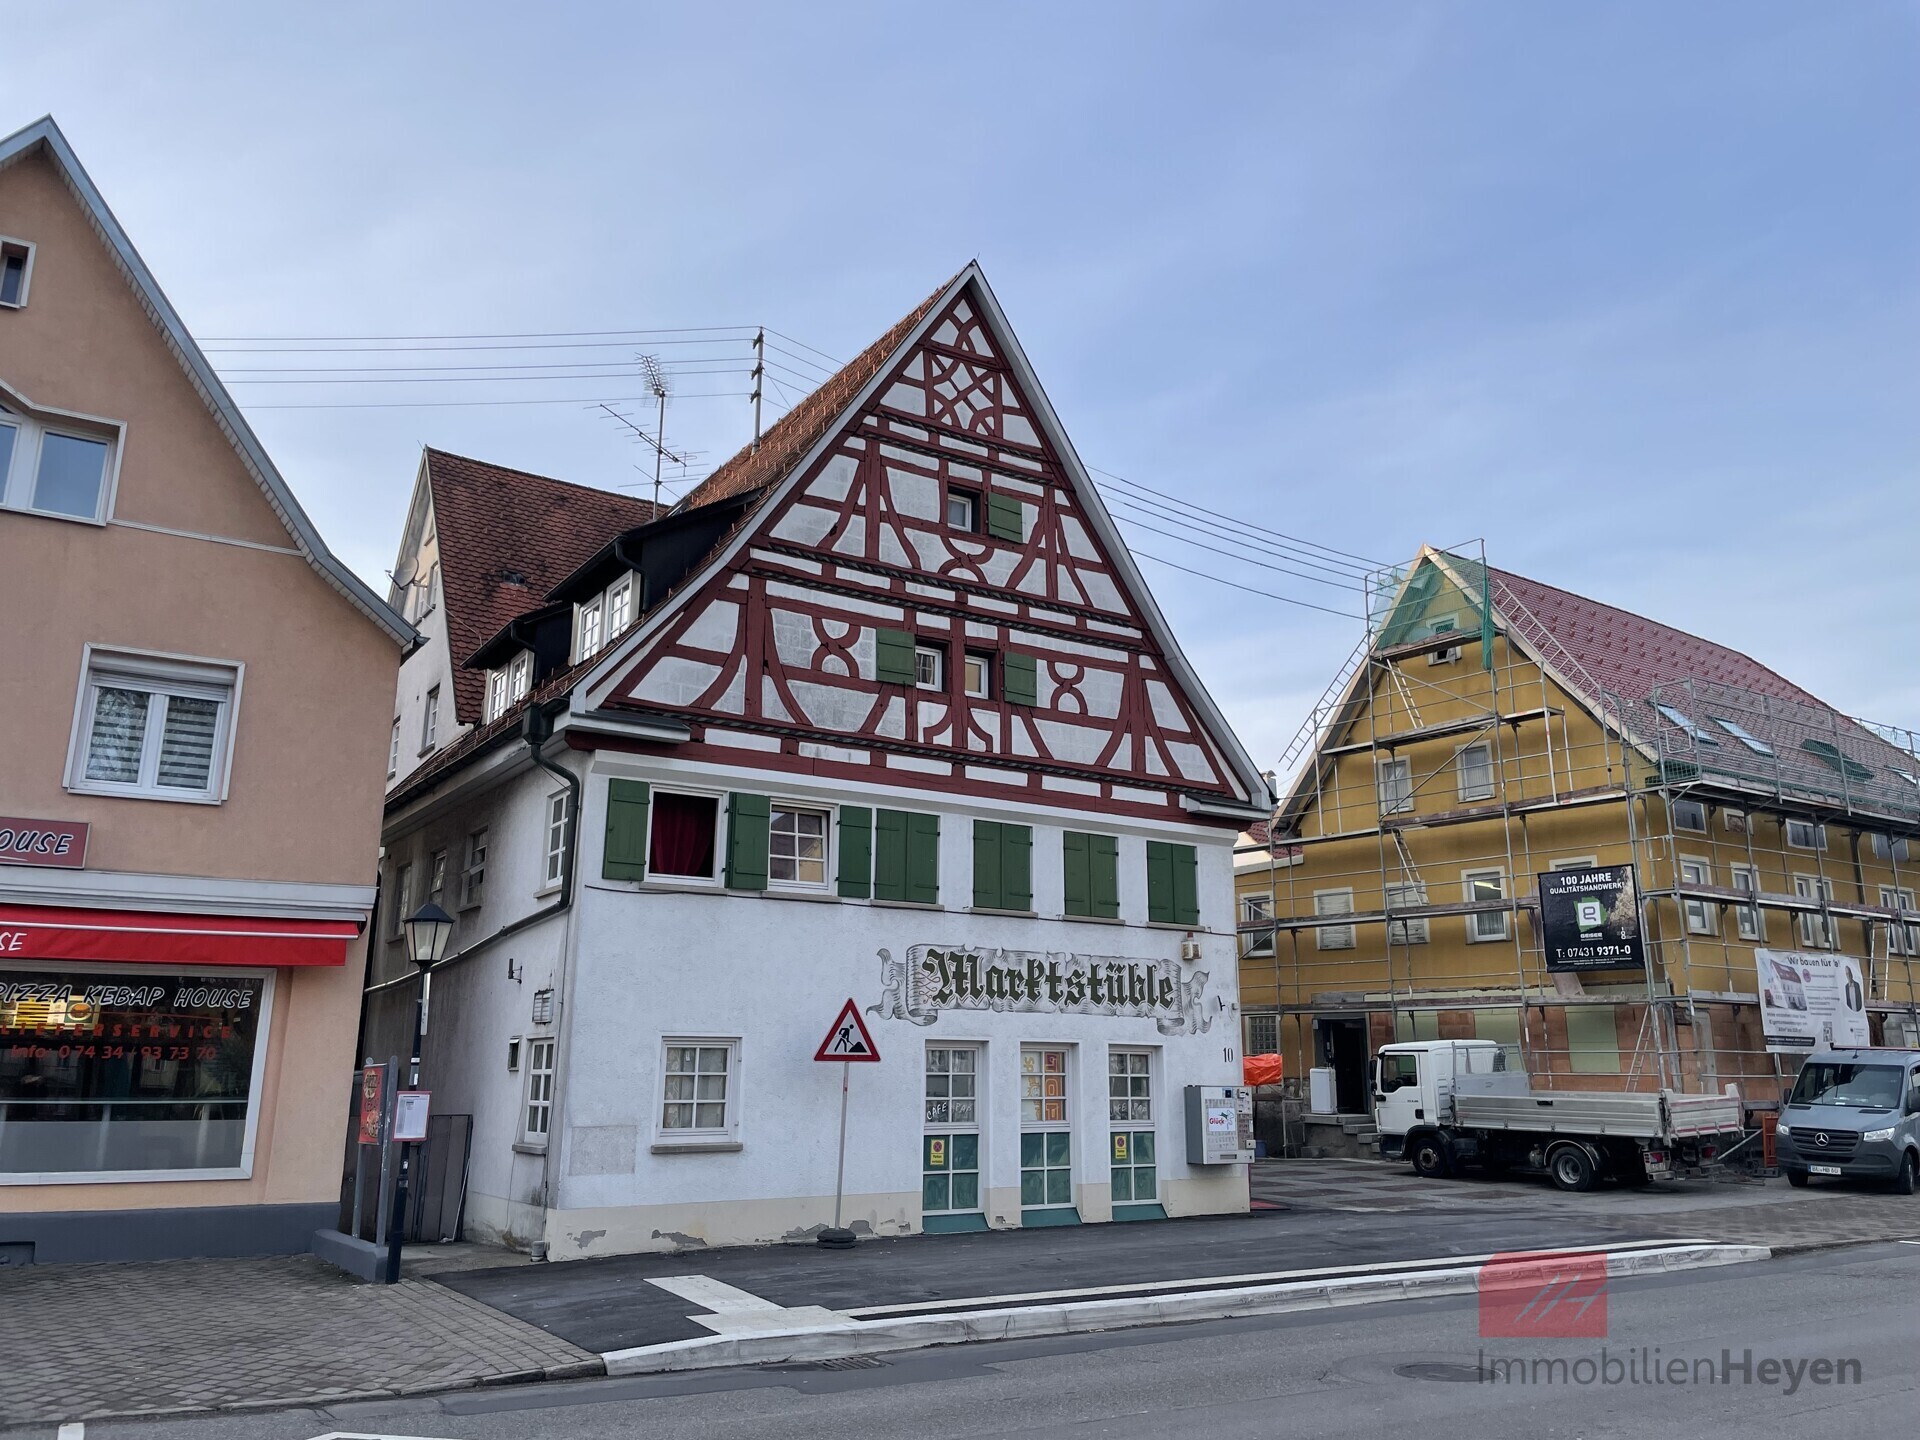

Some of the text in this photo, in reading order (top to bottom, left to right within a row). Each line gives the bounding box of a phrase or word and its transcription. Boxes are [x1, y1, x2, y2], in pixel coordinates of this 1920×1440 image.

[1560, 872, 1612, 886] 100 JAHRE
[1549, 882, 1625, 894] QUALITÄTSHANDWERK!
[1556, 944, 1631, 958] T: 07431 9371-0
[921, 949, 1175, 1009] Marktstüble
[83, 984, 165, 1006] KEBAP
[173, 987, 253, 1009] HOUSE
[141, 1046, 162, 1060] 93
[169, 1046, 190, 1060] 73
[196, 1046, 217, 1060] 70
[1223, 1047, 1234, 1063] 10
[1209, 1117, 1225, 1126] Glück
